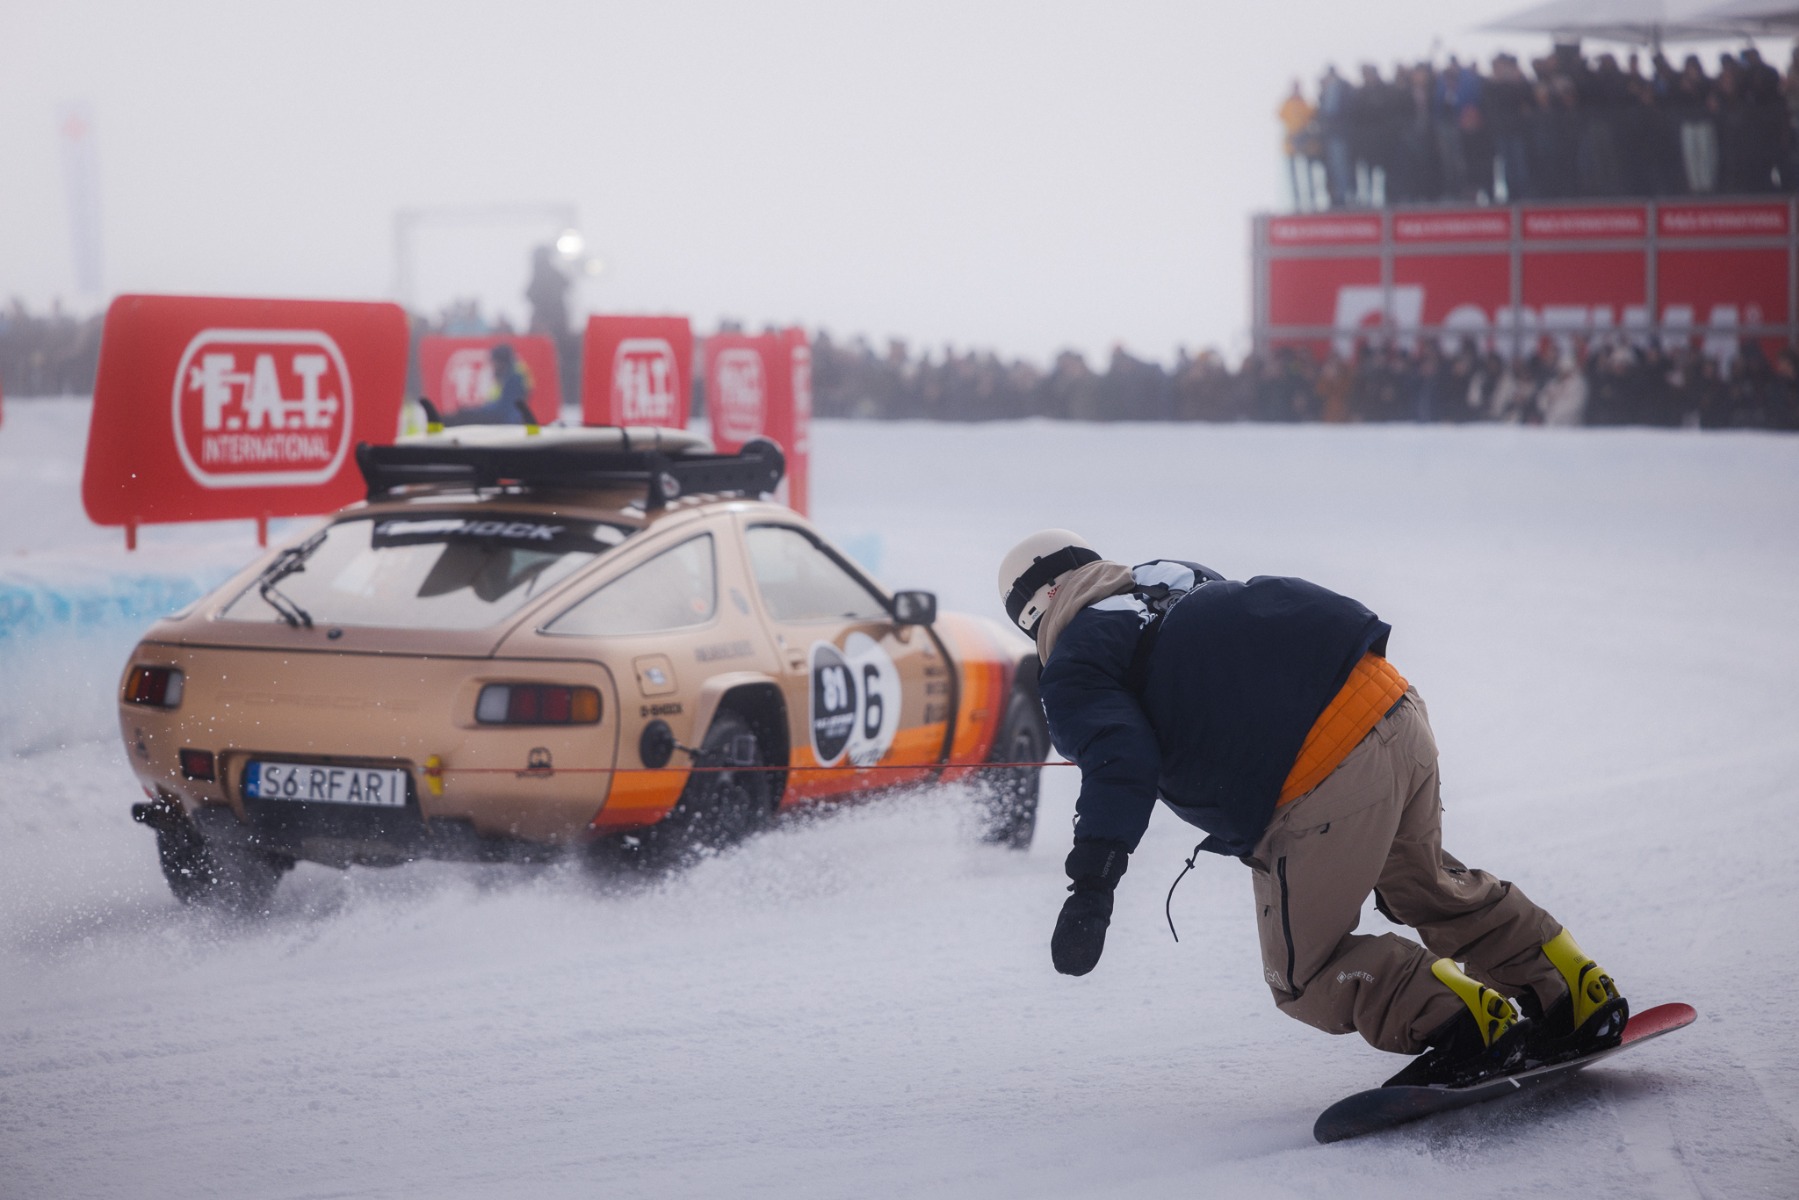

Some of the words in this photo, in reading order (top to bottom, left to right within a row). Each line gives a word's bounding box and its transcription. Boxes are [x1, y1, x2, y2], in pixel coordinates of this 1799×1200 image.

[203, 434, 331, 463] INTERNATIONAL
[864, 664, 884, 739] 6
[264, 766, 299, 797] S6
